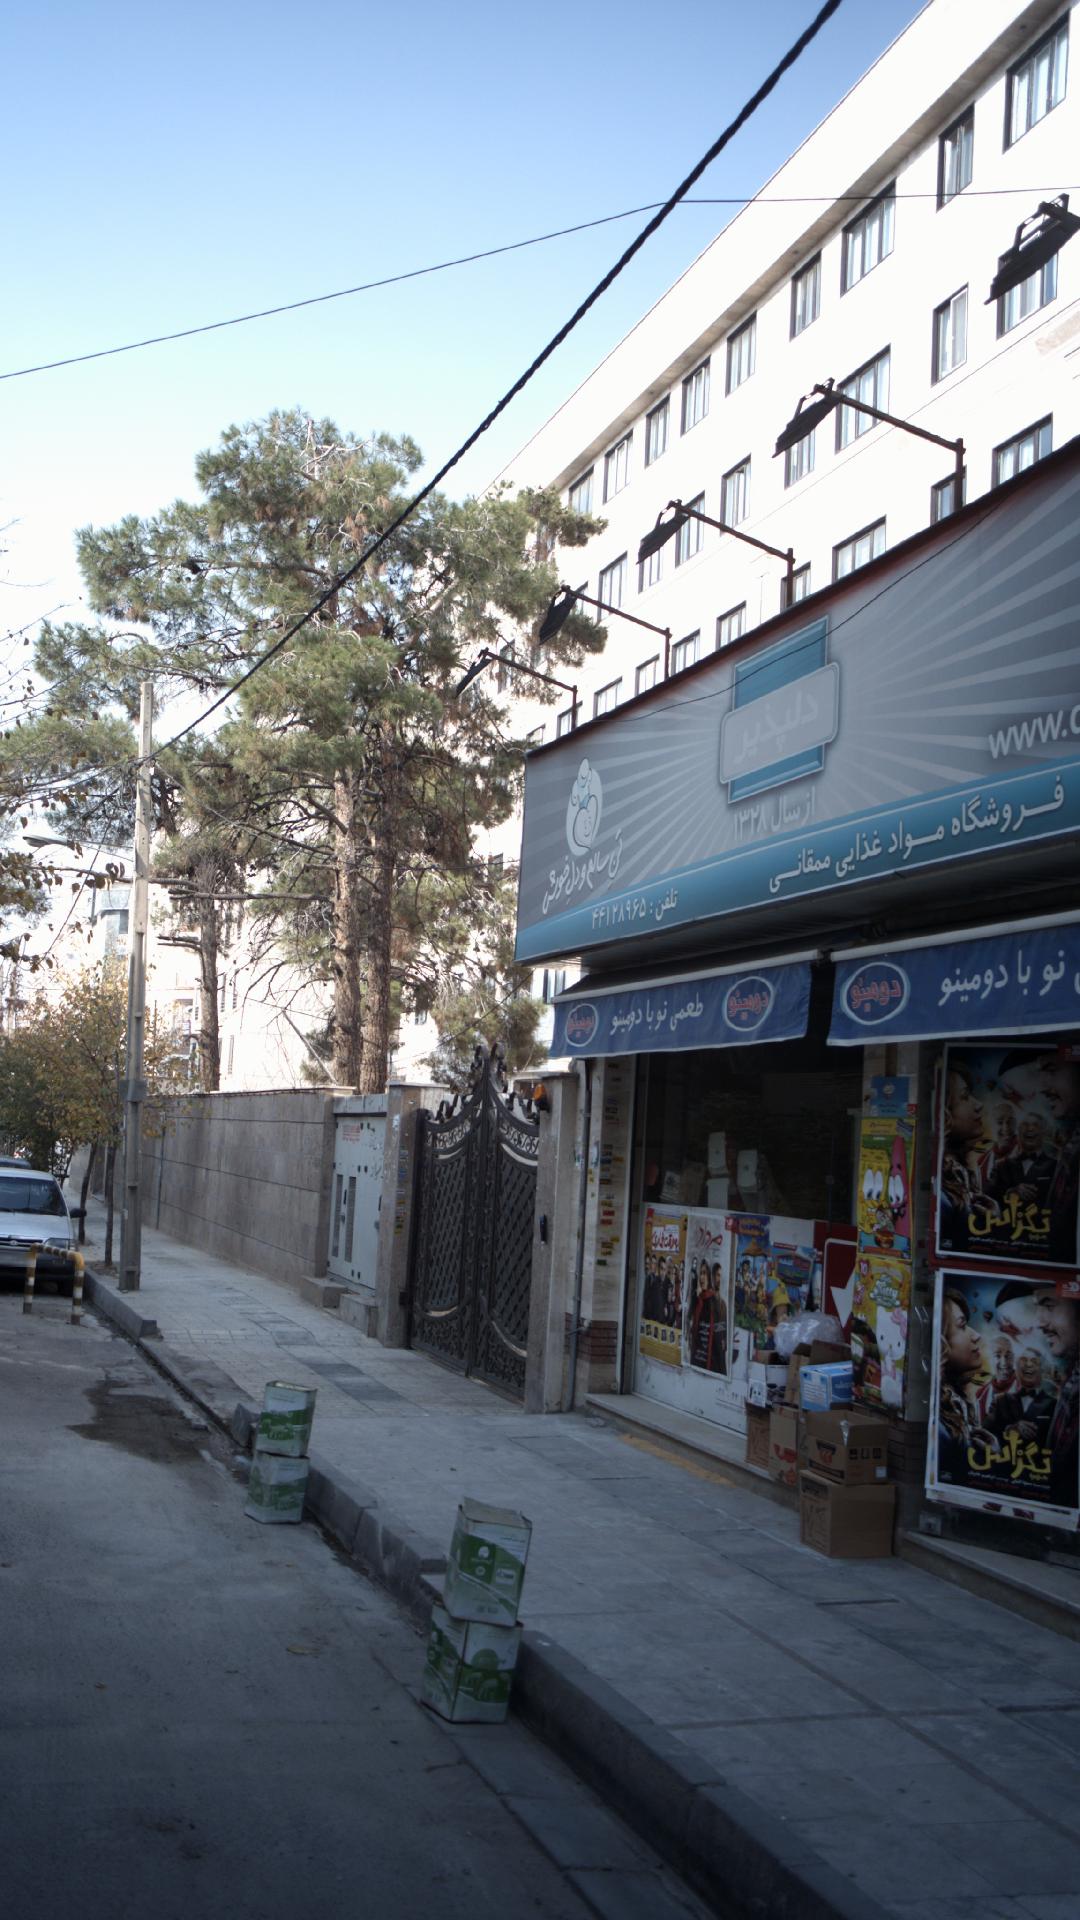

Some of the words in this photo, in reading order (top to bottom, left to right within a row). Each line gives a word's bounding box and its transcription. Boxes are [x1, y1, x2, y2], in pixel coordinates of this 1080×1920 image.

[732, 690, 820, 765] دلپذیر
[733, 803, 768, 841] ۱۳۲۸
[770, 795, 801, 832] سال
[800, 785, 816, 827] از
[951, 774, 1066, 835] فروشگاه
[834, 829, 882, 878] غذایی
[887, 819, 945, 859] مواد
[769, 847, 831, 894] ممقانی
[592, 896, 647, 930] ۴۴۱۲۸۹۶۵
[938, 963, 1009, 1007] دومینو
[1017, 949, 1032, 996] با
[1039, 949, 1066, 997] نو
[645, 999, 654, 1031] با
[654, 1000, 668, 1032] نو
[669, 991, 704, 1032] طعمی
[850, 977, 902, 1013] دومینو
[609, 1006, 643, 1036] دومینو
[967, 1192, 1052, 1241] تگزاس
[967, 1428, 1053, 1479] تگزاس
